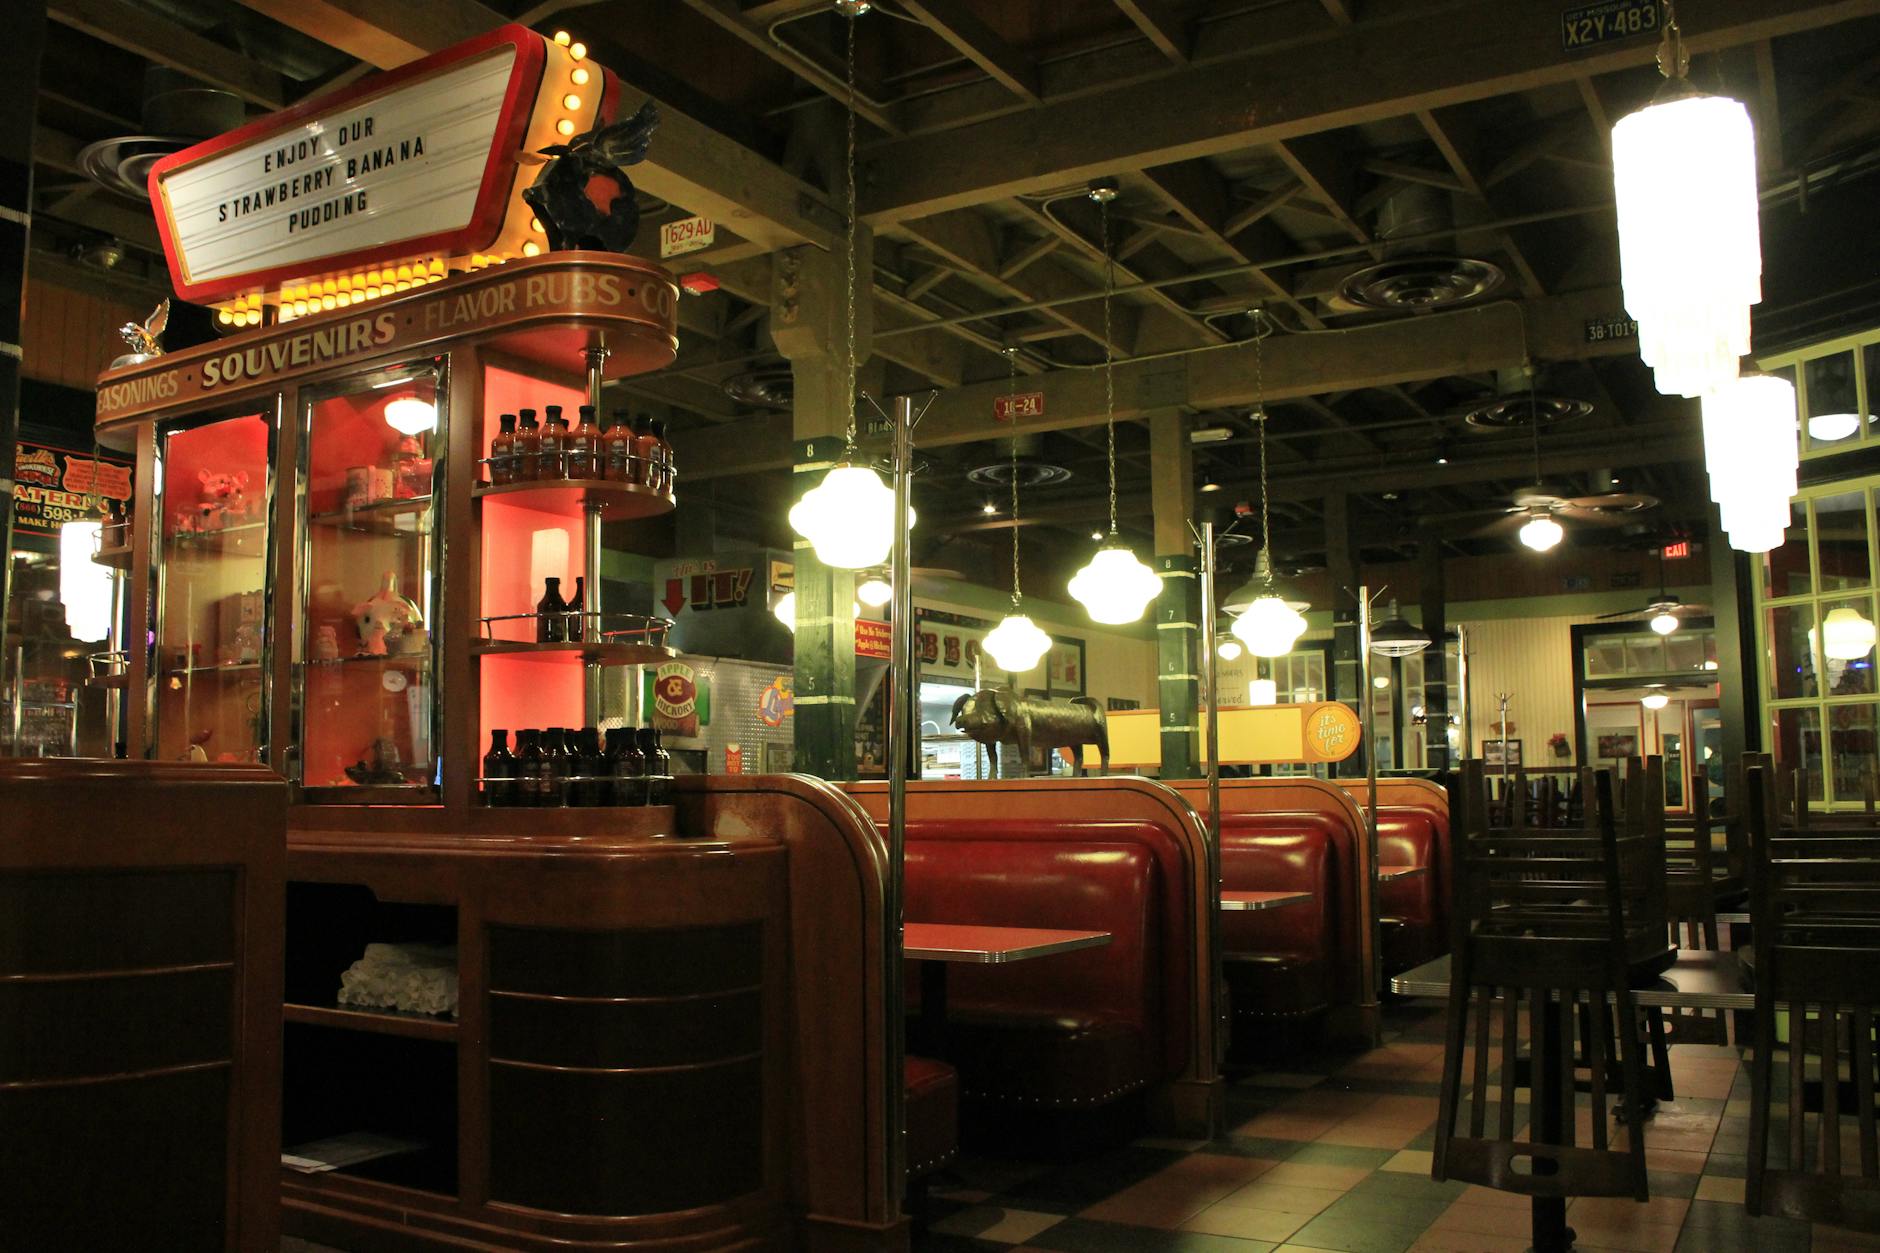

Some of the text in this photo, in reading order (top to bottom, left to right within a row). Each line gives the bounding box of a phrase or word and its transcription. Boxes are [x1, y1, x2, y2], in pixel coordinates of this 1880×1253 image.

[264, 117, 374, 173] ENJOY OUR
[219, 137, 424, 223] STRAWBERRY BANANA
[289, 192, 368, 234] PUDDING
[425, 272, 622, 331] FLAVOR RUBS
[201, 313, 396, 391] SOUVENIRS
[806, 444, 815, 458] 8
[1665, 542, 1687, 557] EXIT
[660, 663, 692, 678] APPLE
[667, 679, 684, 697] &
[657, 698, 693, 716] HICKORY
